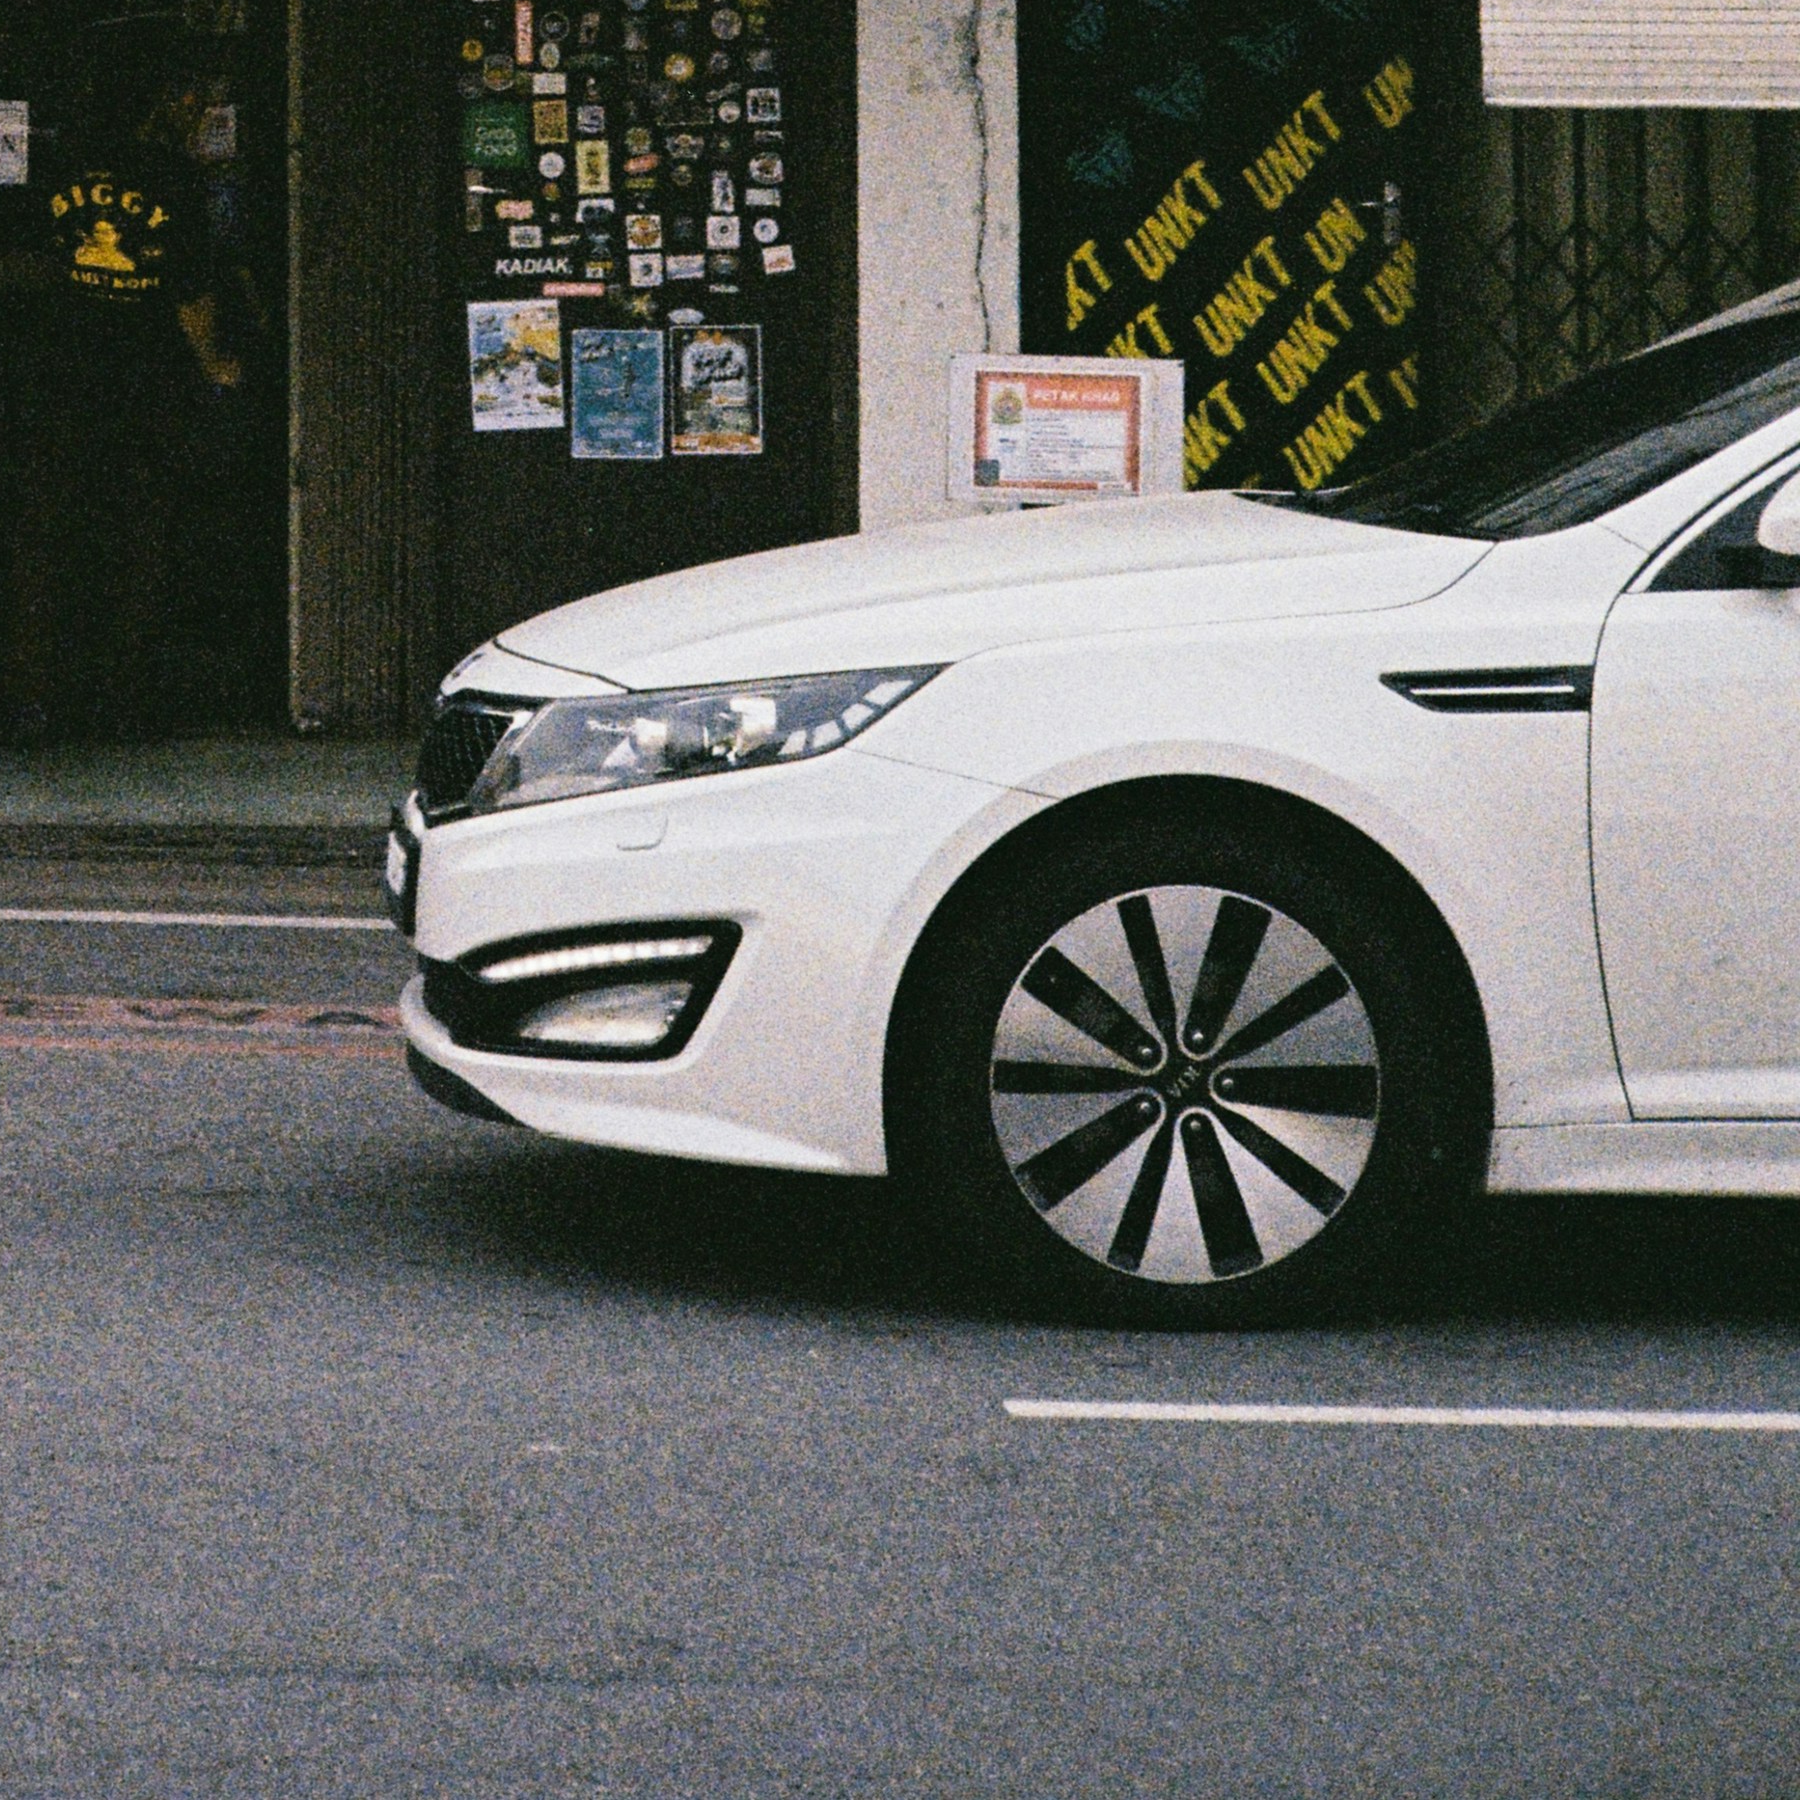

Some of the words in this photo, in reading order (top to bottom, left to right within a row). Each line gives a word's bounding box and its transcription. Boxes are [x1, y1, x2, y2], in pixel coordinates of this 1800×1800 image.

[1124, 159, 1223, 281] UNKT
[1242, 90, 1342, 211] UNKT
[1193, 235, 1292, 357] UNKT
[1256, 279, 1354, 405] UNKT
[1283, 370, 1383, 490] UNKT
